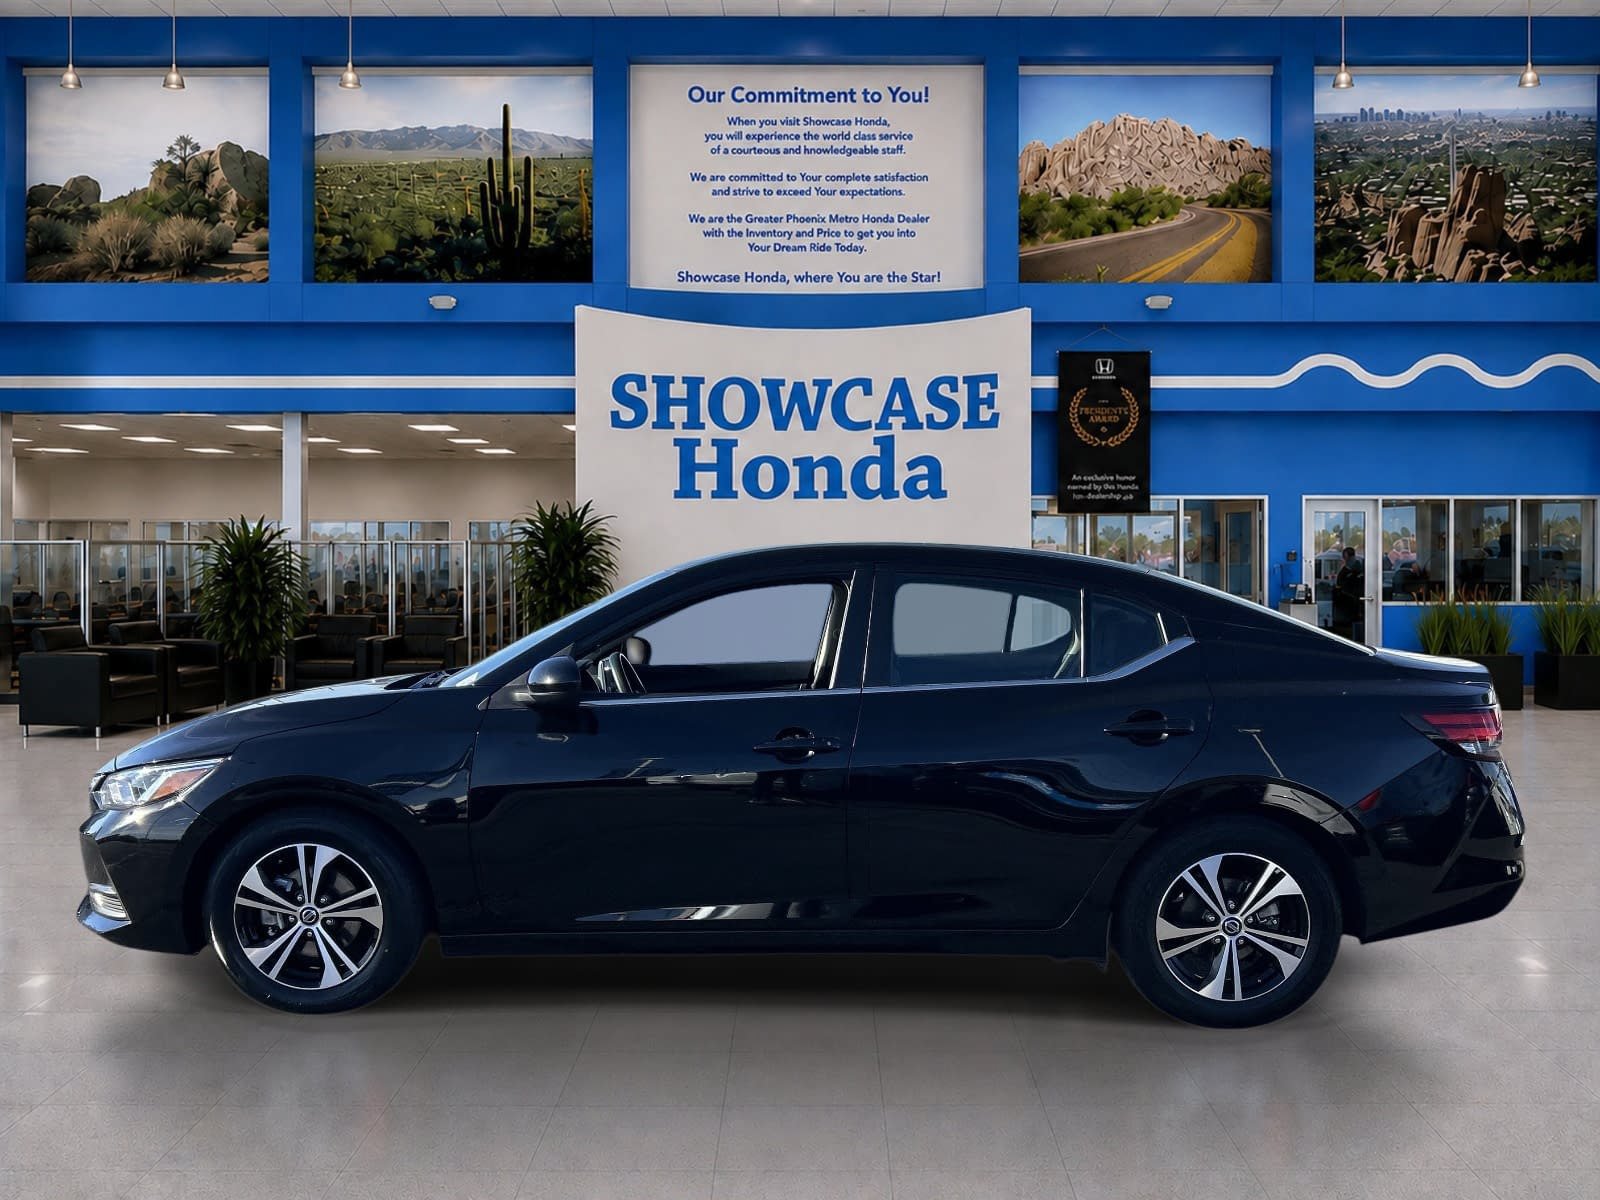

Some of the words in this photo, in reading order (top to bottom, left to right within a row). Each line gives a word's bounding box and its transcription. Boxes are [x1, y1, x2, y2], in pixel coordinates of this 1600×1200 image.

[687, 86, 726, 104] Our
[730, 86, 857, 104] Commitment
[861, 88, 883, 104] to
[886, 86, 930, 104] You!
[726, 117, 757, 127] When
[758, 119, 778, 129] you
[779, 117, 801, 127] visit
[802, 117, 853, 127] Showcase
[854, 117, 891, 128] Honda,
[704, 134, 724, 144] you
[725, 131, 743, 141] will
[745, 131, 801, 144] experience
[802, 131, 820, 141] the
[821, 131, 851, 141] world
[853, 131, 877, 141] class
[878, 131, 914, 142] service
[710, 145, 722, 155] of
[730, 147, 781, 156] courteous
[782, 145, 802, 155] and
[881, 145, 906, 155] staff.
[689, 173, 708, 183] We
[728, 173, 784, 183] committed
[785, 174, 798, 183] to
[799, 173, 823, 183] Your
[824, 173, 872, 185] complete
[873, 172, 929, 183] satisfaction
[711, 186, 731, 197] and
[732, 187, 761, 197] strive
[762, 188, 774, 197] to
[775, 187, 812, 197] exceed
[813, 187, 838, 197] Your
[838, 187, 906, 200] expectations.
[688, 214, 706, 224] We
[707, 216, 725, 224] are
[725, 214, 743, 224] the
[744, 214, 785, 224] Greater
[785, 214, 827, 224] Phoenix
[828, 214, 860, 224] Metro
[861, 214, 895, 224] Honda
[897, 214, 931, 224] Dealer
[702, 228, 725, 238] with
[726, 228, 744, 238] the
[745, 228, 794, 241] Inventory
[794, 228, 815, 238] and
[816, 228, 842, 238] Price
[843, 230, 855, 238] to
[856, 230, 875, 241] get
[876, 231, 895, 241] you
[896, 228, 917, 238] into
[747, 243, 772, 253] Your
[772, 243, 808, 253] Dream
[809, 243, 833, 253] Ride
[833, 243, 868, 255] Today.
[677, 271, 741, 284] Showcase
[744, 271, 790, 286] Honda,
[793, 271, 834, 284] where
[836, 272, 861, 284] You
[863, 275, 884, 284] are
[886, 271, 908, 284] the
[911, 272, 941, 284] Star!
[609, 373, 1001, 431] SHOWCASE
[673, 434, 949, 500] Honda
